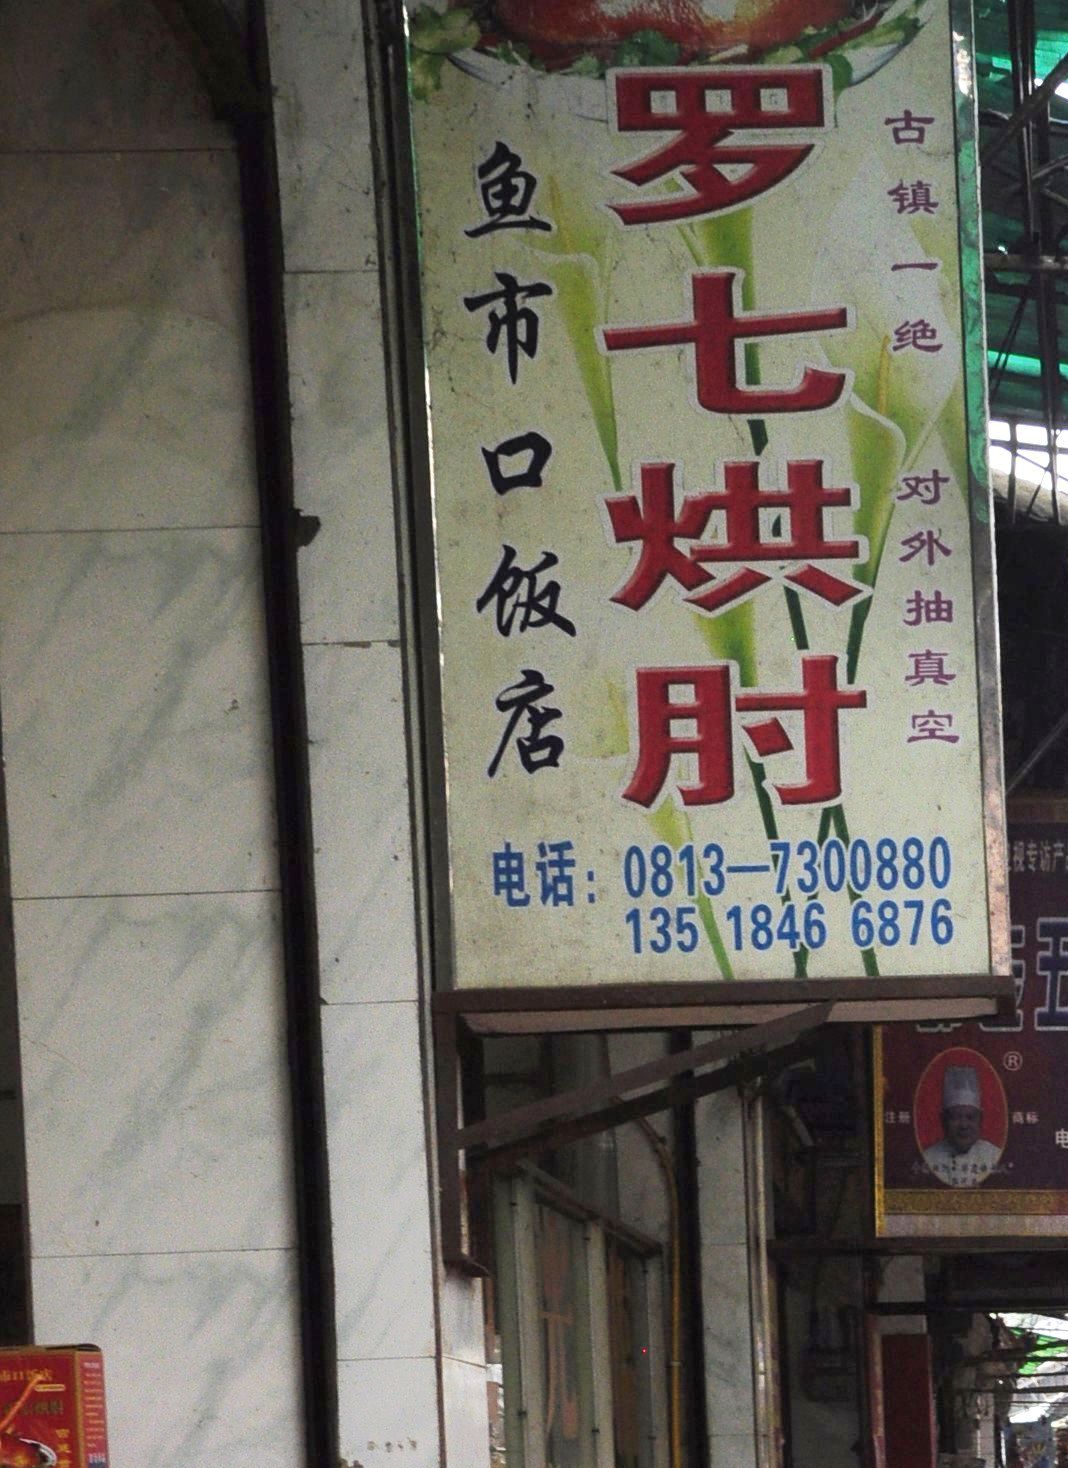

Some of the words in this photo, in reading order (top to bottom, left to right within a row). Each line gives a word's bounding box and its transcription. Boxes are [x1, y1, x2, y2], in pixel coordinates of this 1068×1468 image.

[884, 109, 943, 354] 古镇一绝
[463, 140, 576, 780] 鱼市口饭店
[602, 66, 867, 809] 罗七烘肘
[896, 468, 961, 745] 对外抽真空
[492, 841, 596, 908] 电话：
[626, 906, 700, 955] 135
[726, 901, 827, 952] 1846
[851, 898, 955, 949] 6876
